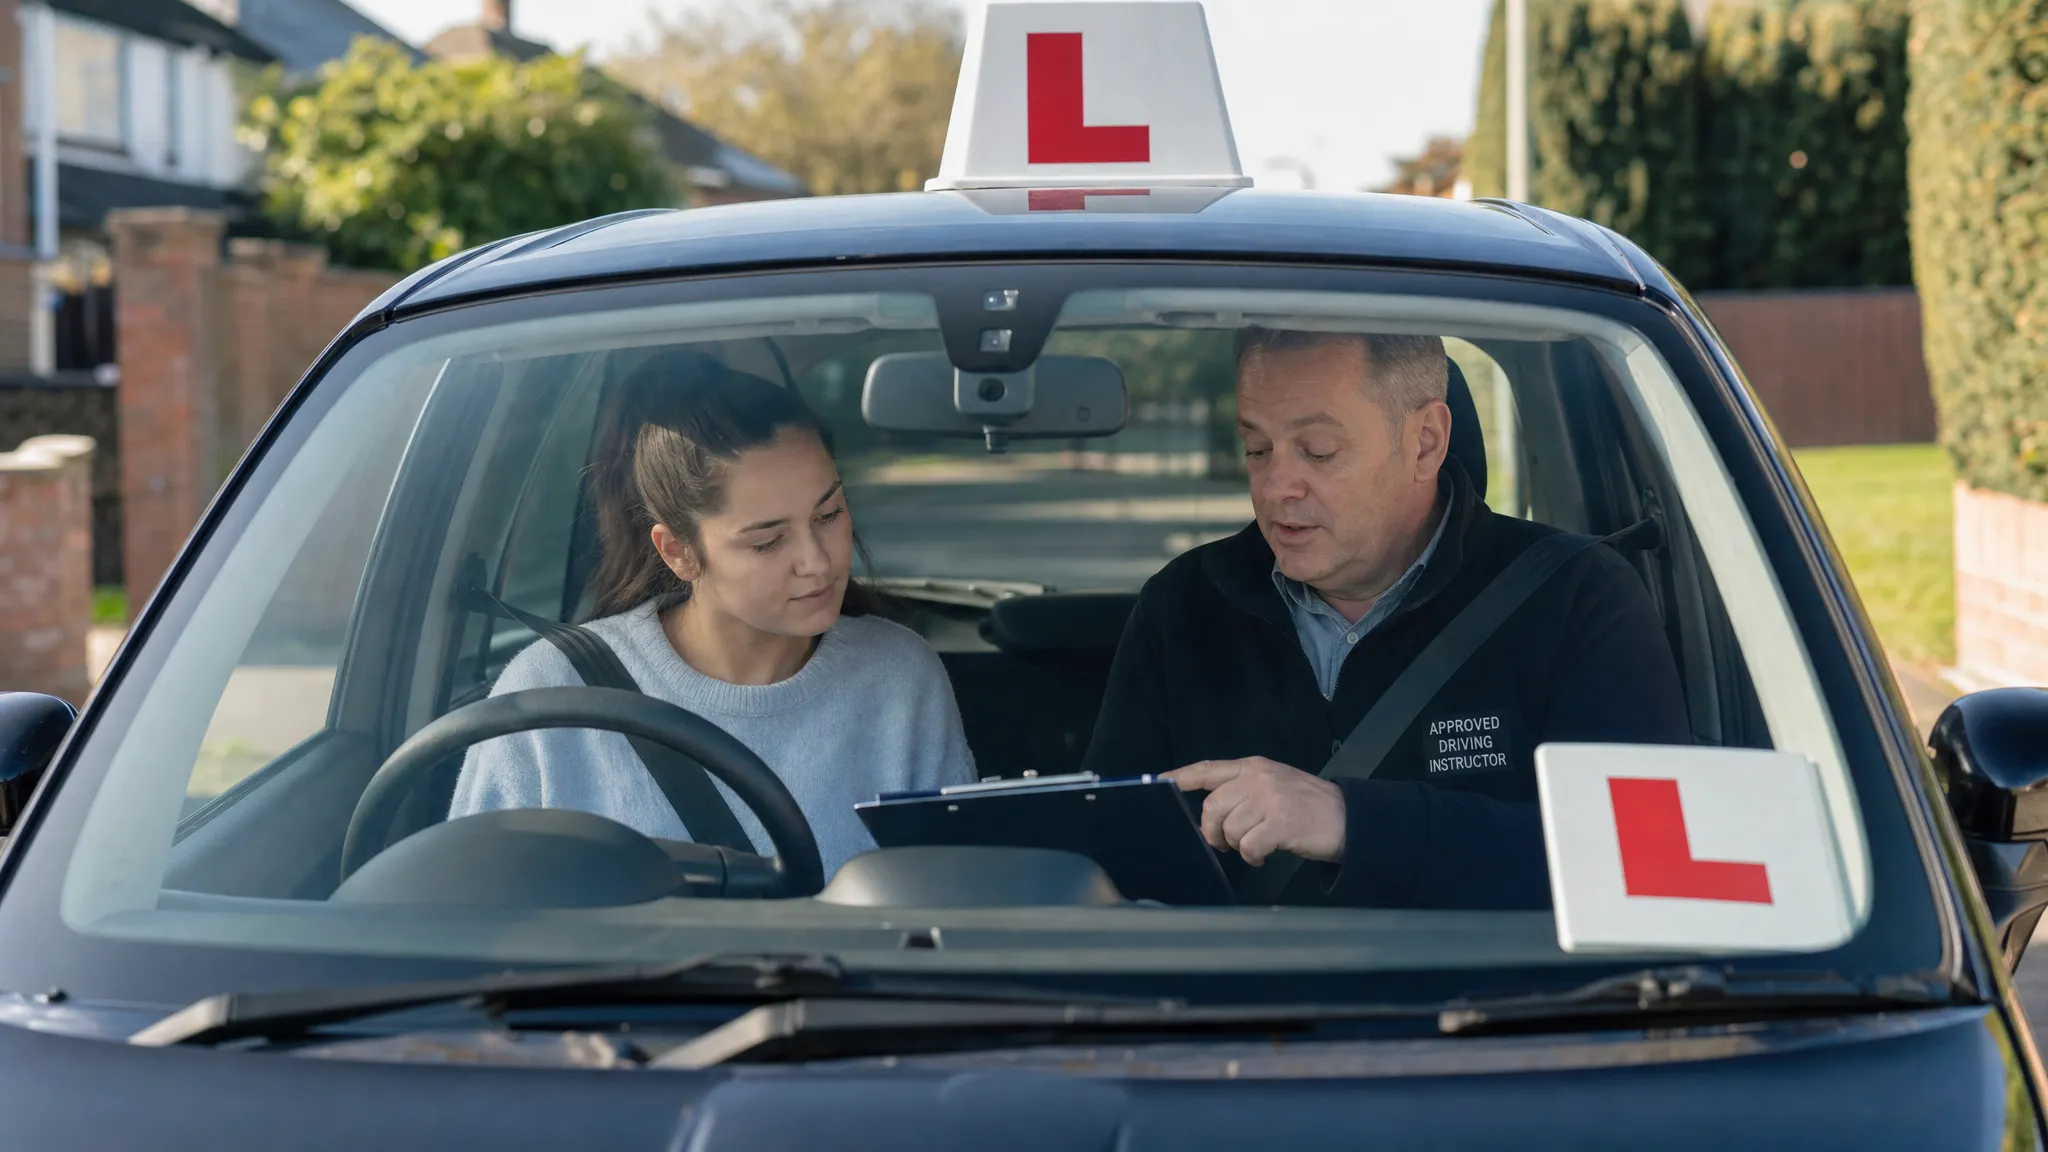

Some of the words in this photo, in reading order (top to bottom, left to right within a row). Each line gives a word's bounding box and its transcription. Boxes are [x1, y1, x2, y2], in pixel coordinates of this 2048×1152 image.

[1027, 33, 1150, 164] L
[1429, 716, 1500, 735] APPROVED
[1439, 735, 1492, 753] DRIVING
[1429, 752, 1507, 773] INSTRUCTOR
[1608, 777, 1773, 904] L
